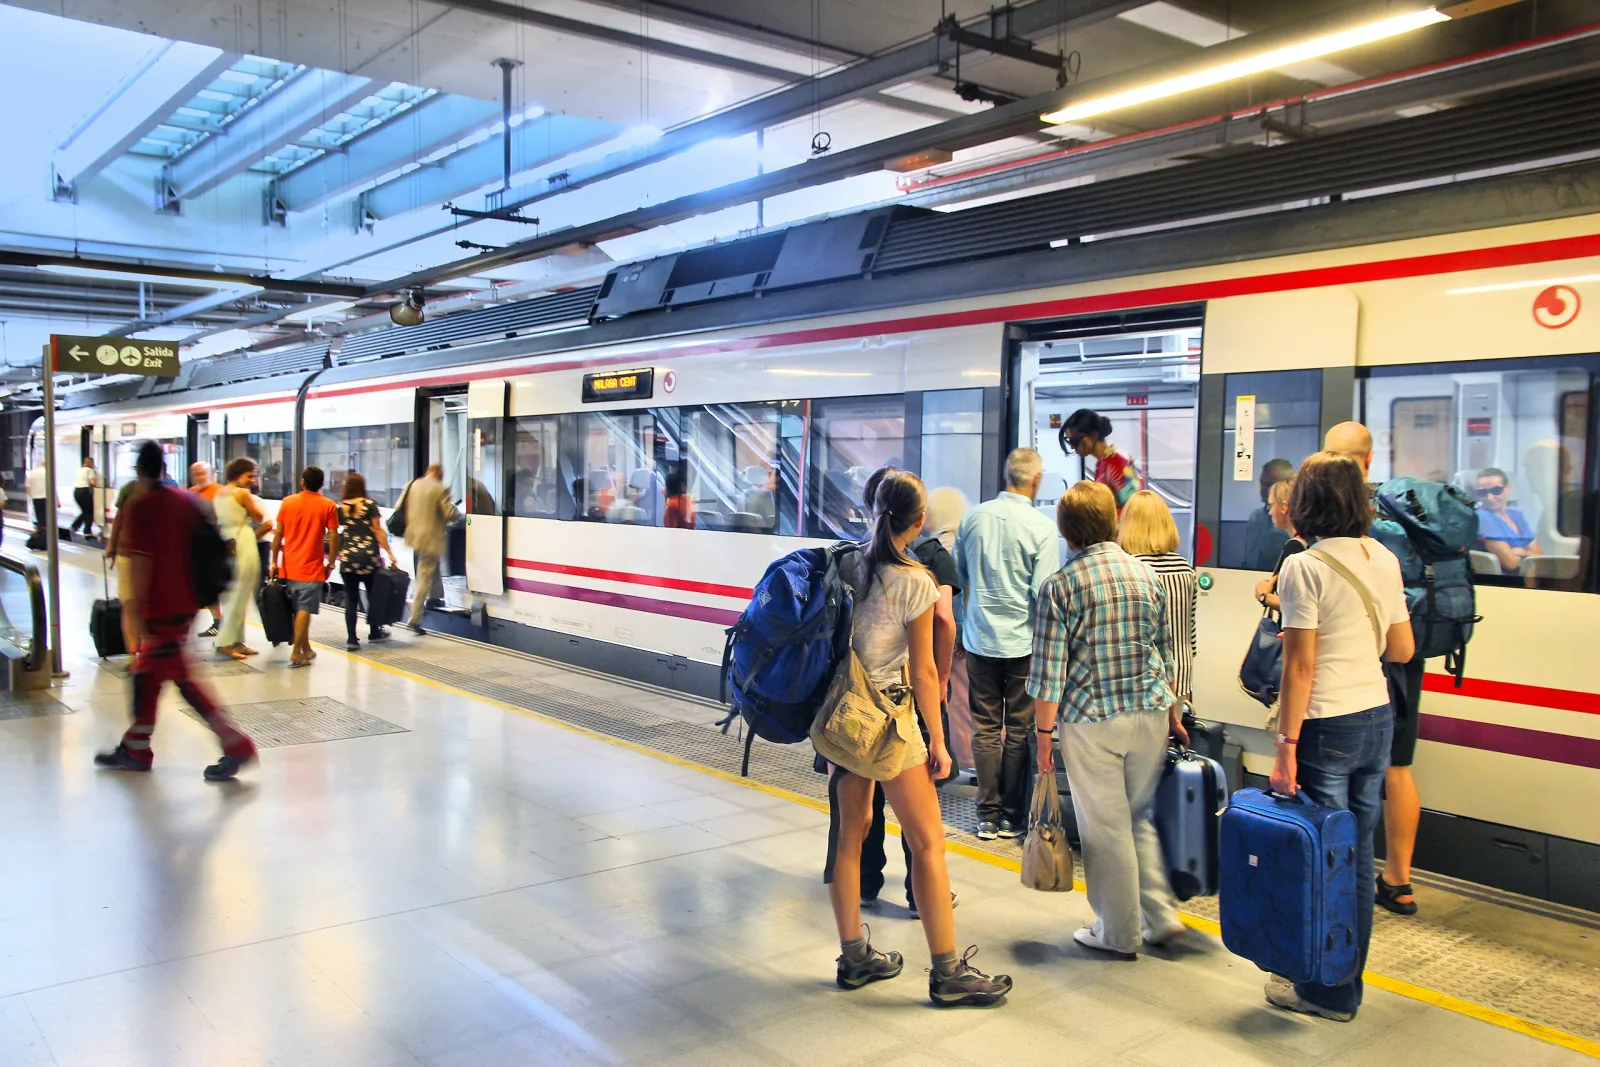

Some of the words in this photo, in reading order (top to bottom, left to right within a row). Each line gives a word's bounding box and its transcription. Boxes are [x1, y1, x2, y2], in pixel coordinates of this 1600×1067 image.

[144, 346, 174, 357] Salida
[144, 358, 163, 368] Exit
[593, 377, 617, 389] MALAGA
[620, 376, 637, 387] CENT
